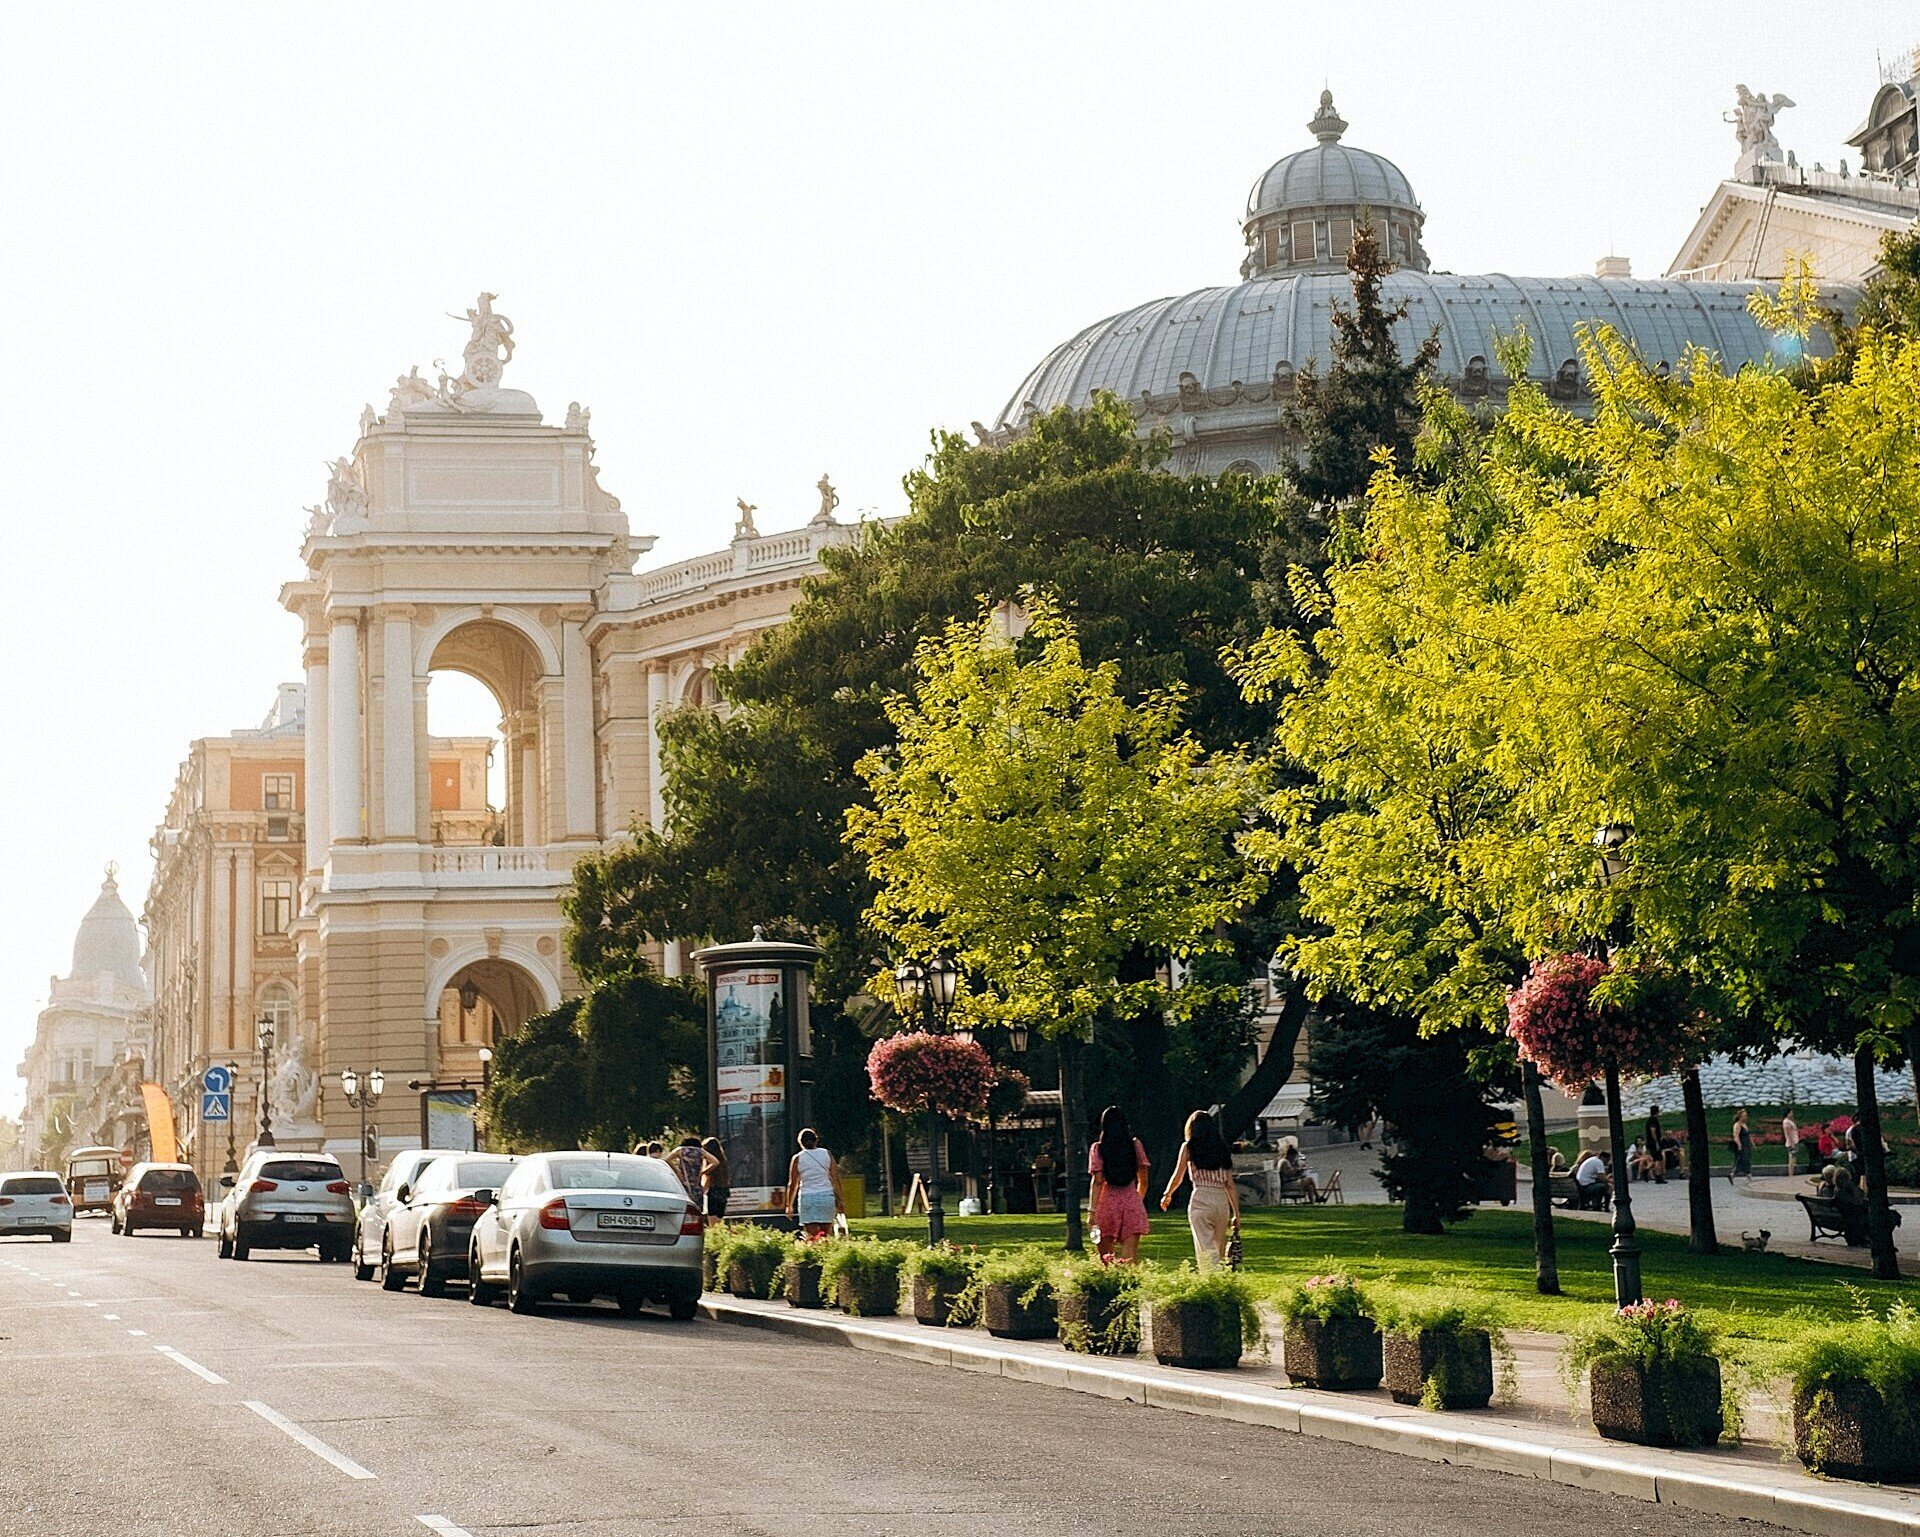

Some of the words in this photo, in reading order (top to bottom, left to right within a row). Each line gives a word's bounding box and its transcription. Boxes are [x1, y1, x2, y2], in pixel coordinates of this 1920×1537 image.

[603, 1215, 616, 1224] BH
[617, 1216, 639, 1226] 4906
[640, 1217, 653, 1226] EM
